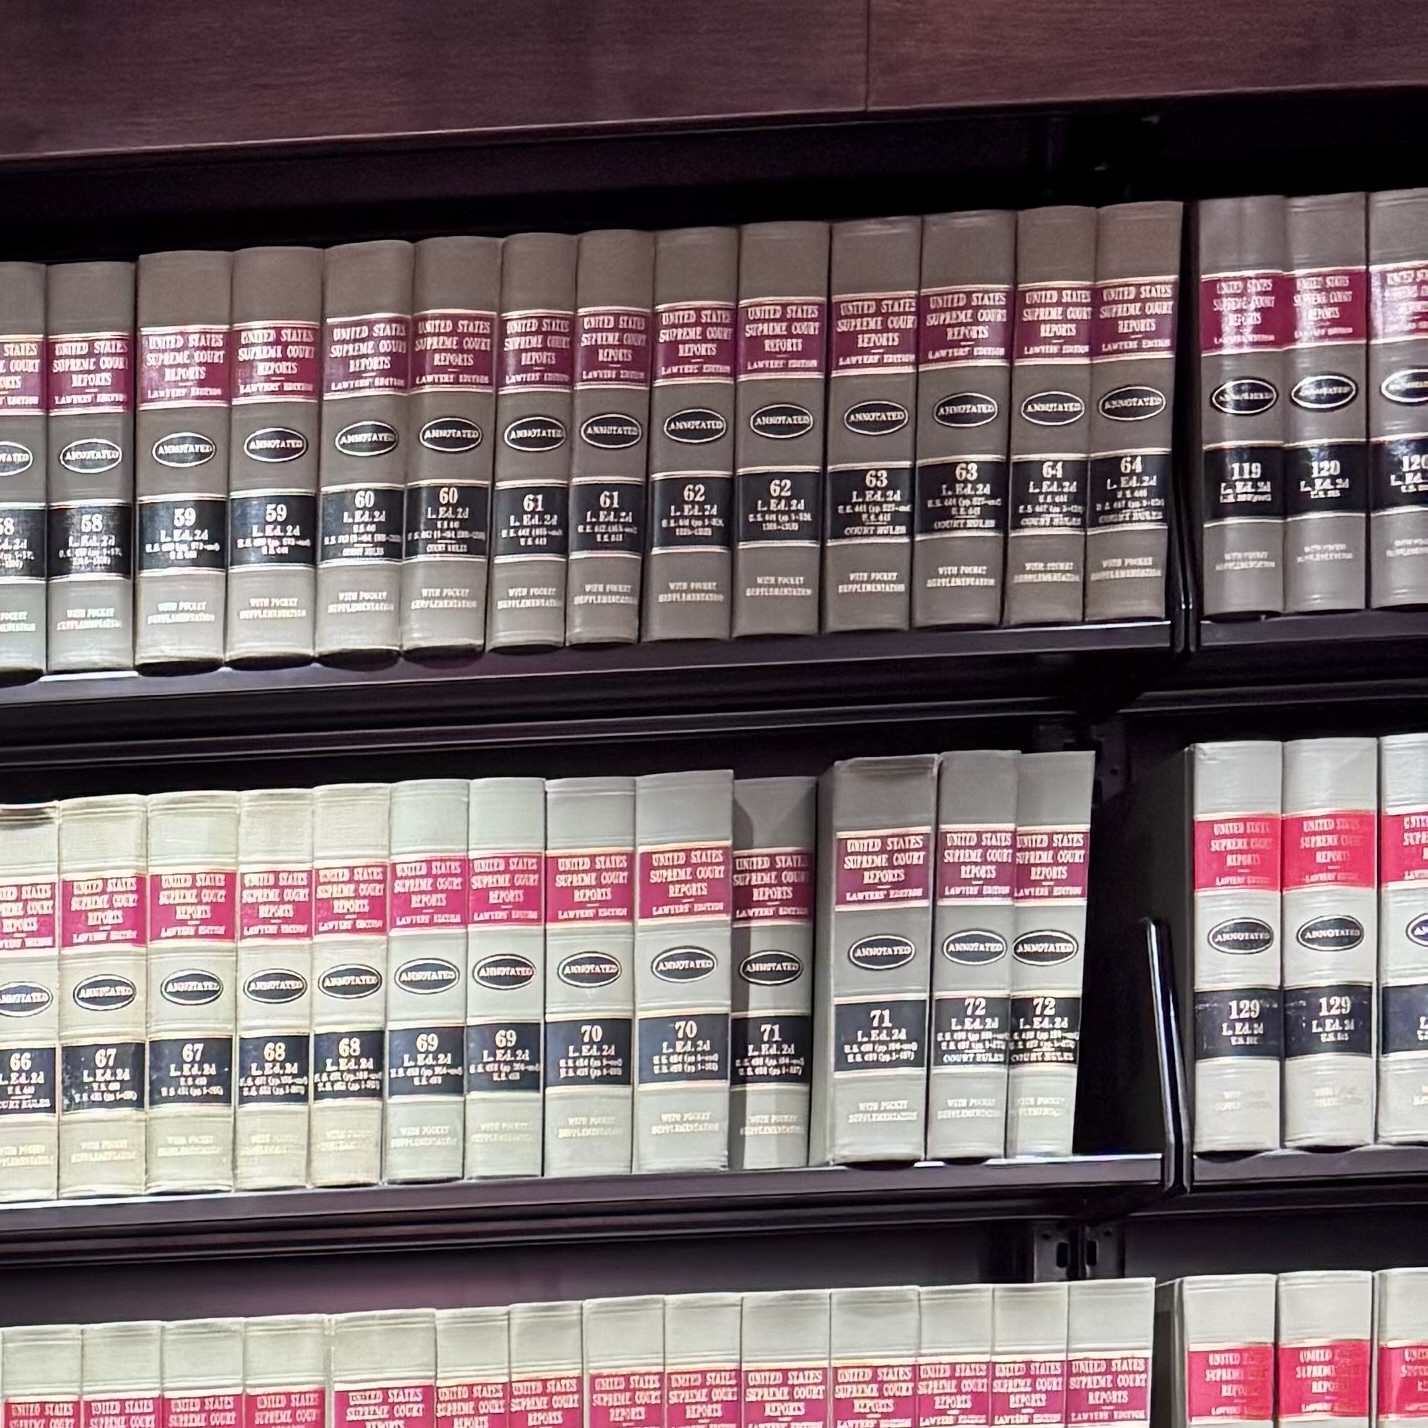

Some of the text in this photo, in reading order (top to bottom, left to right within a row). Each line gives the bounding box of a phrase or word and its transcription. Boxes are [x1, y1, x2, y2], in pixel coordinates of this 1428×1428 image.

[840, 301, 876, 315] UNITED
[857, 333, 900, 348] REPORTS
[769, 479, 792, 497] 62
[865, 469, 888, 488] 63
[354, 490, 375, 509] 60
[523, 493, 544, 512] 61
[173, 507, 197, 528] 59
[846, 836, 924, 853] UNITED STATES
[844, 851, 926, 870] SUPREME COURT
[863, 869, 906, 884] REPORTS
[964, 997, 987, 1016] 72
[1227, 999, 1260, 1020] 129
[869, 1008, 893, 1028] 71
[580, 1024, 603, 1043] 70
[9, 1052, 32, 1072] 66
[182, 1043, 204, 1063] 67
